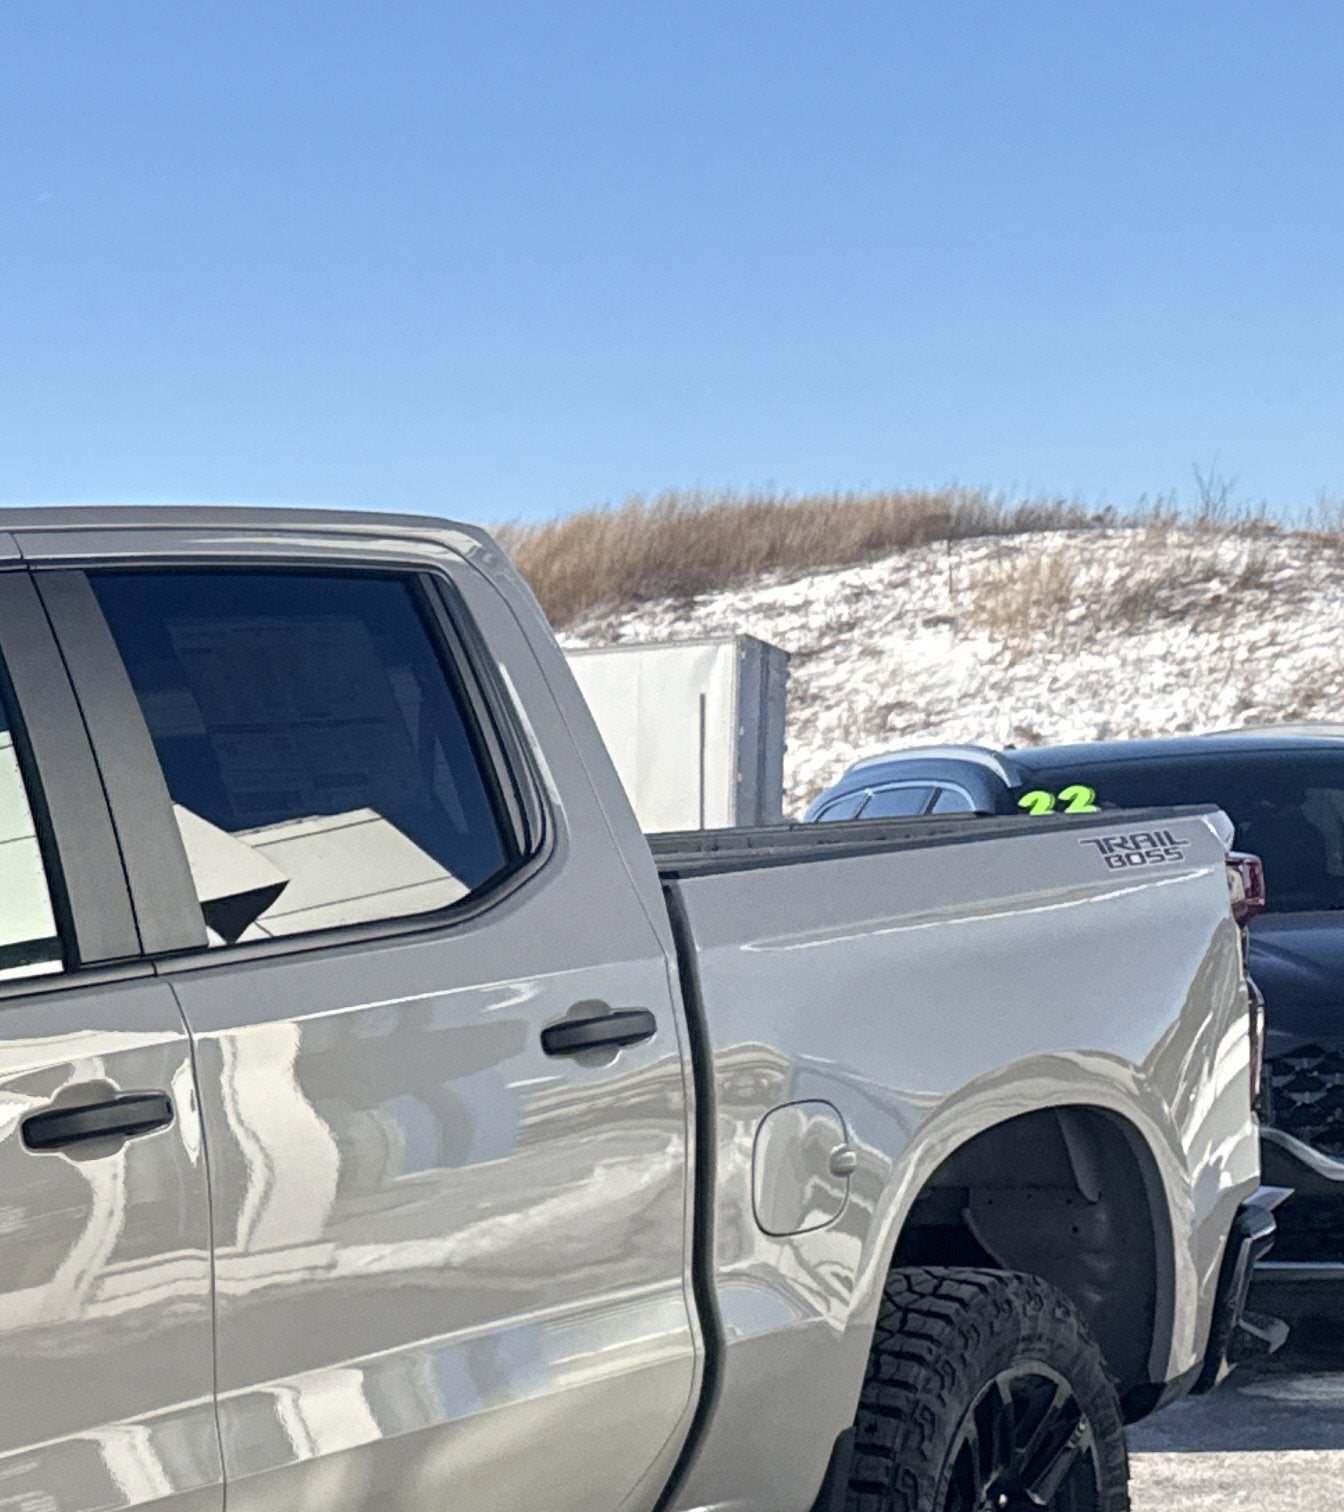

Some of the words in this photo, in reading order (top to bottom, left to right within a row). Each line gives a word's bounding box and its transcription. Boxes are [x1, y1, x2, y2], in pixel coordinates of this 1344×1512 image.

[1017, 785, 1099, 816] 22
[1079, 831, 1189, 855] TRAIL
[1104, 847, 1185, 870] BOSS
